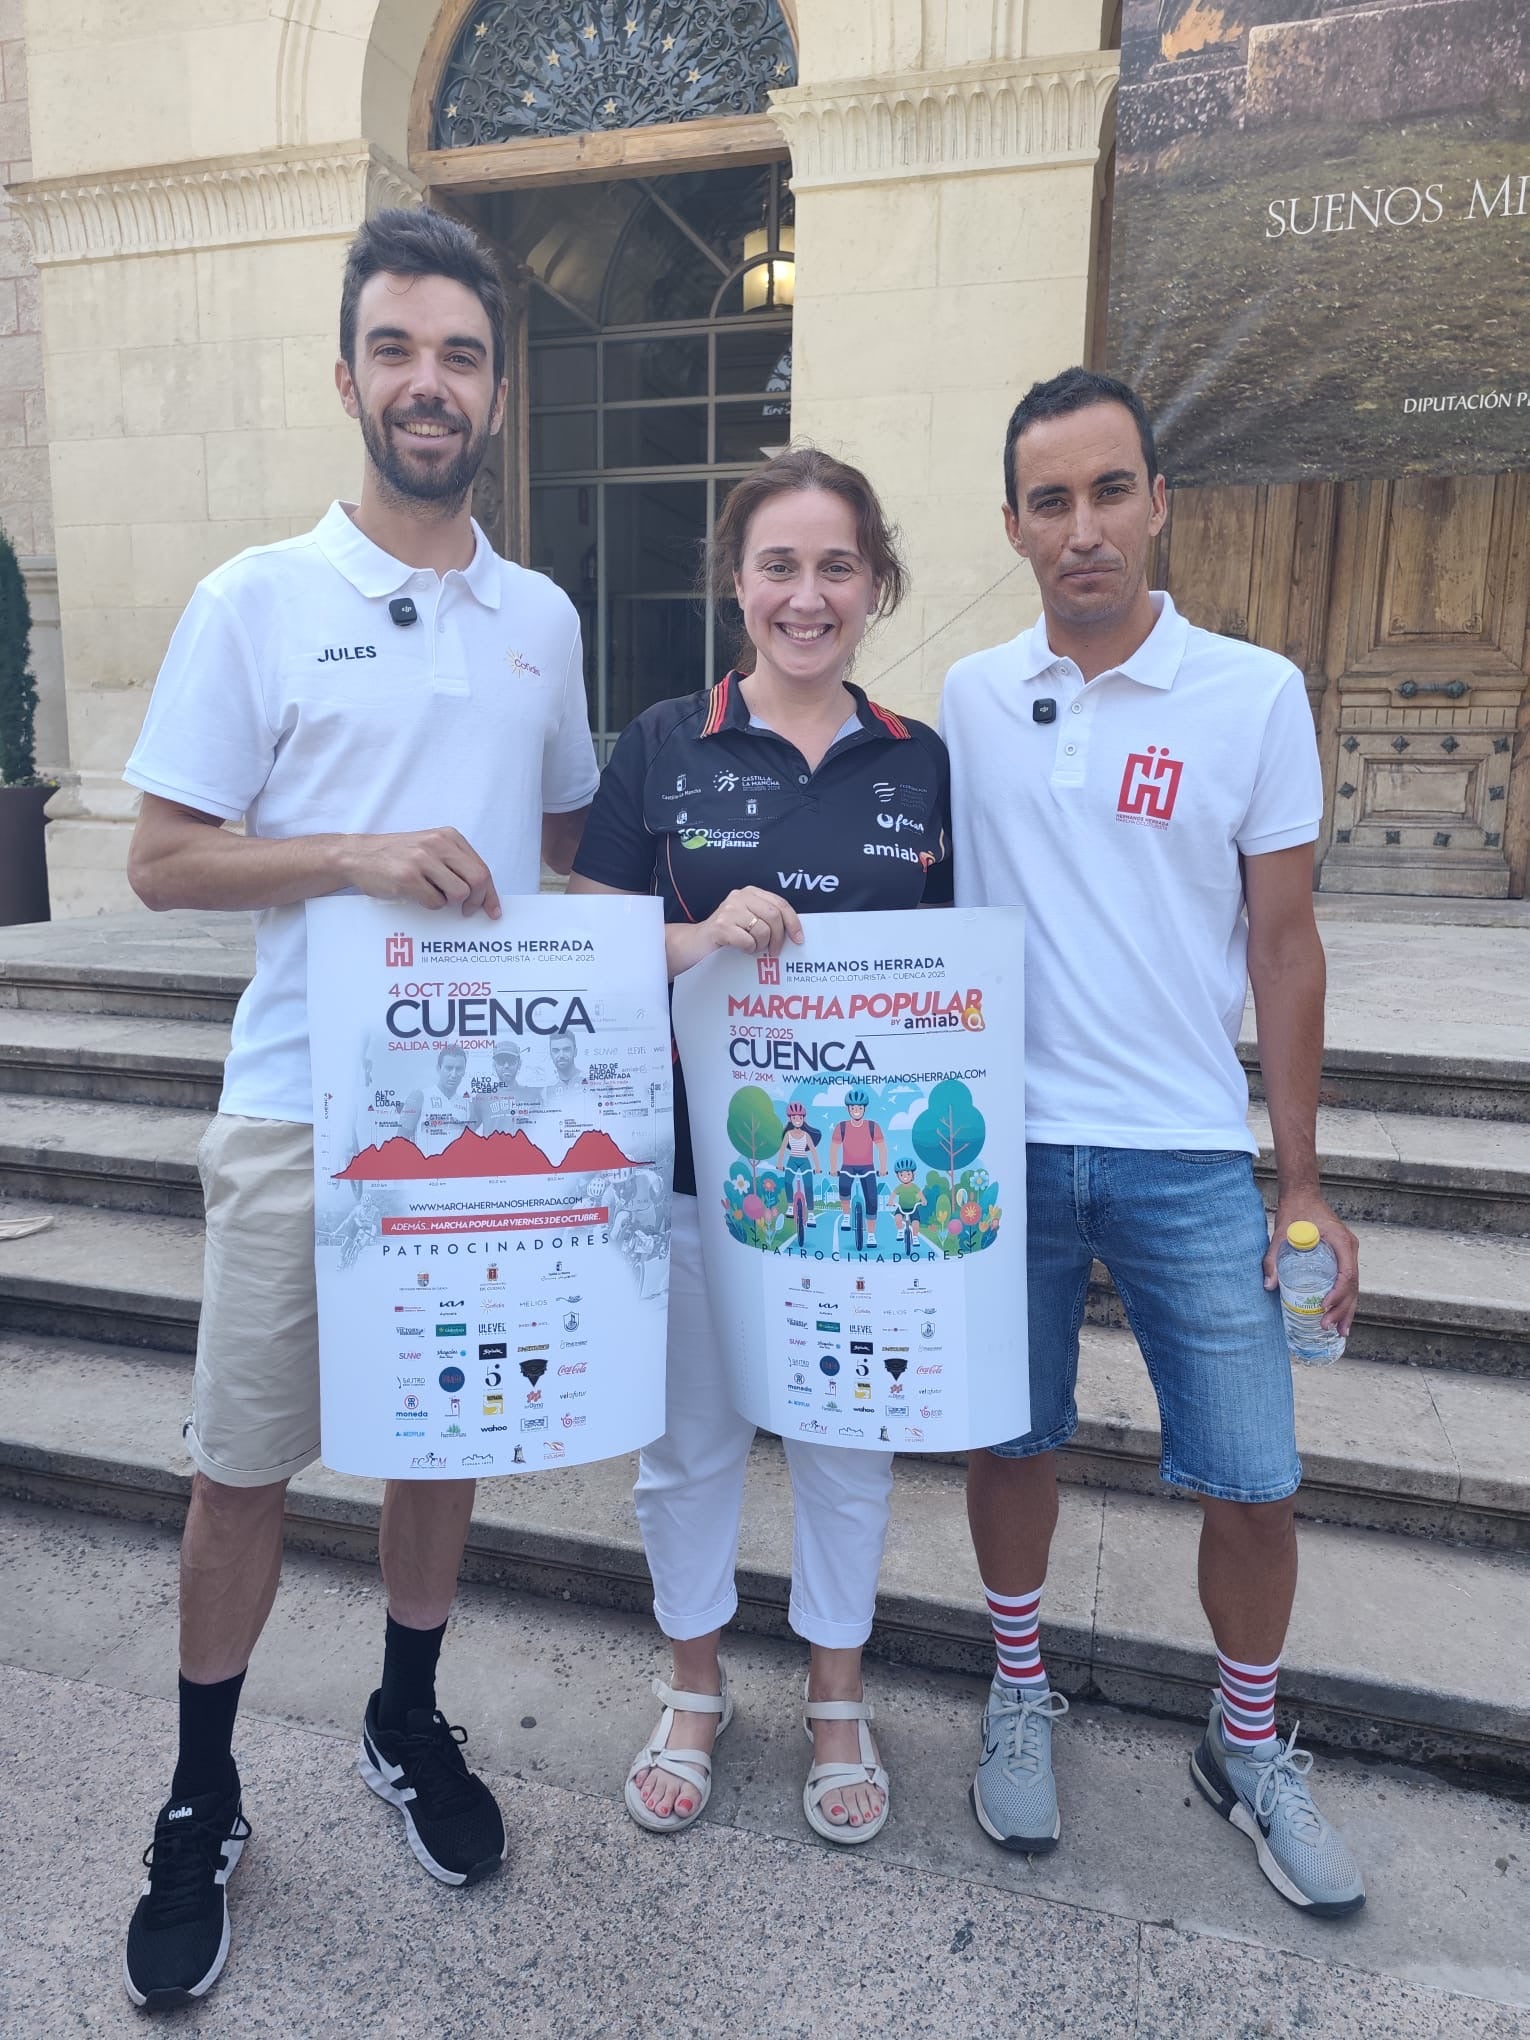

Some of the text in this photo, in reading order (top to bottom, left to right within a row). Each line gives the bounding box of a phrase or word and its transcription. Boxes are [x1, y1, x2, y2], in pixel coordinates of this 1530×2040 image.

[1265, 183, 1443, 238] SUEÑOS
[1403, 390, 1512, 413] DIPUTACIÓN
[317, 645, 377, 663] JULES
[863, 843, 919, 863] amiab
[777, 869, 840, 893] vive
[421, 940, 594, 953] HERMANOS HERRADA
[471, 955, 530, 963] CICLOTURISTA
[576, 954, 595, 962] 2025
[786, 957, 945, 973] HERMANOS HERRADA
[793, 975, 828, 983] MARCHA
[830, 973, 886, 983] CICLOTURISTA
[893, 972, 926, 980] CUENCA
[928, 970, 946, 979] 2025
[388, 982, 491, 997] 4 OCT 2025
[728, 988, 983, 1020] MARCHA POPULAR
[386, 996, 595, 1038] CUENCA
[890, 1012, 959, 1029] BY amiab
[730, 1025, 794, 1040] 3 OCT 2025
[388, 1041, 430, 1051] SALIDA
[729, 1037, 875, 1072] CUENCA
[782, 1069, 986, 1086] WWW.MARCHAHERMANOSHERRADA.COM
[409, 1197, 583, 1212] WWW.MARCHAHERMANOSHERRADA.COM
[431, 1220, 468, 1230] MARCHA
[469, 1219, 509, 1229] POPULAR
[510, 1217, 543, 1227] VIERNES
[549, 1215, 561, 1225] DE
[383, 1233, 609, 1256] PATROCINADORES
[762, 1243, 964, 1263] PATROCINADORES
[480, 1424, 508, 1433] wahoo
[169, 1806, 193, 1820] Gola
